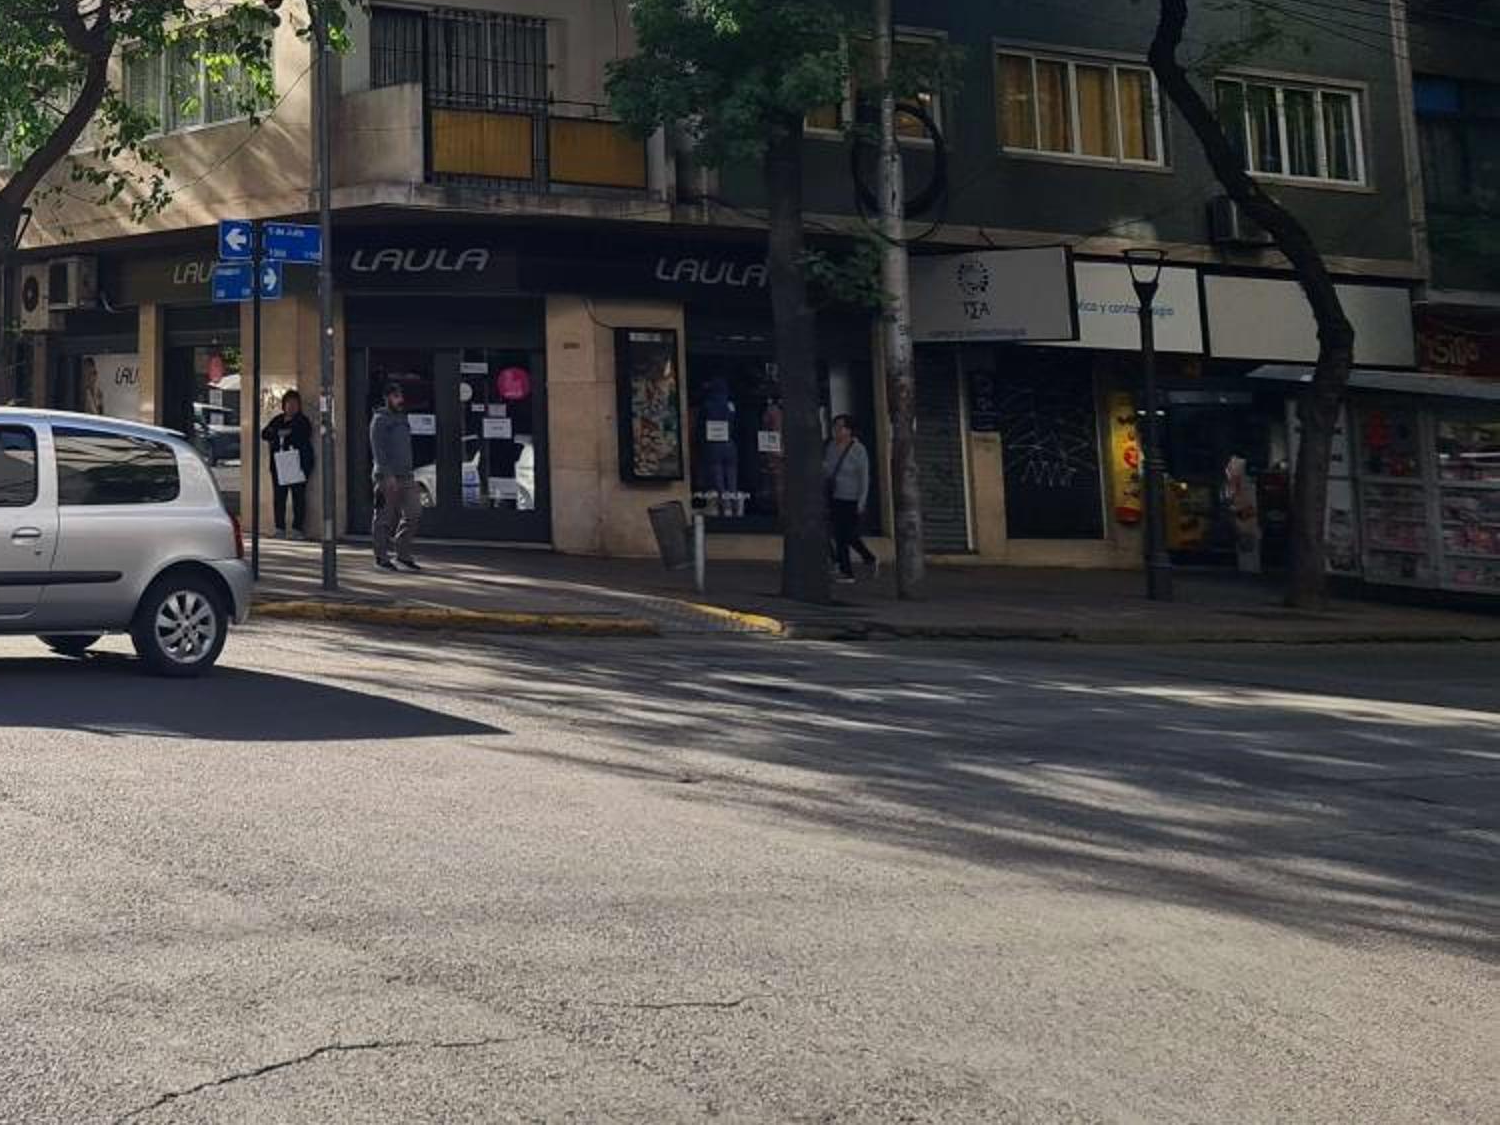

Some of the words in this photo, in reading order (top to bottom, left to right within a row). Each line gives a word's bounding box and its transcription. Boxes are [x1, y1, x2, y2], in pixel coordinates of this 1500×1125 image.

[351, 248, 490, 271] LAULA
[173, 262, 213, 284] LAU
[656, 258, 768, 287] LAULA
[115, 365, 139, 385] LAU
